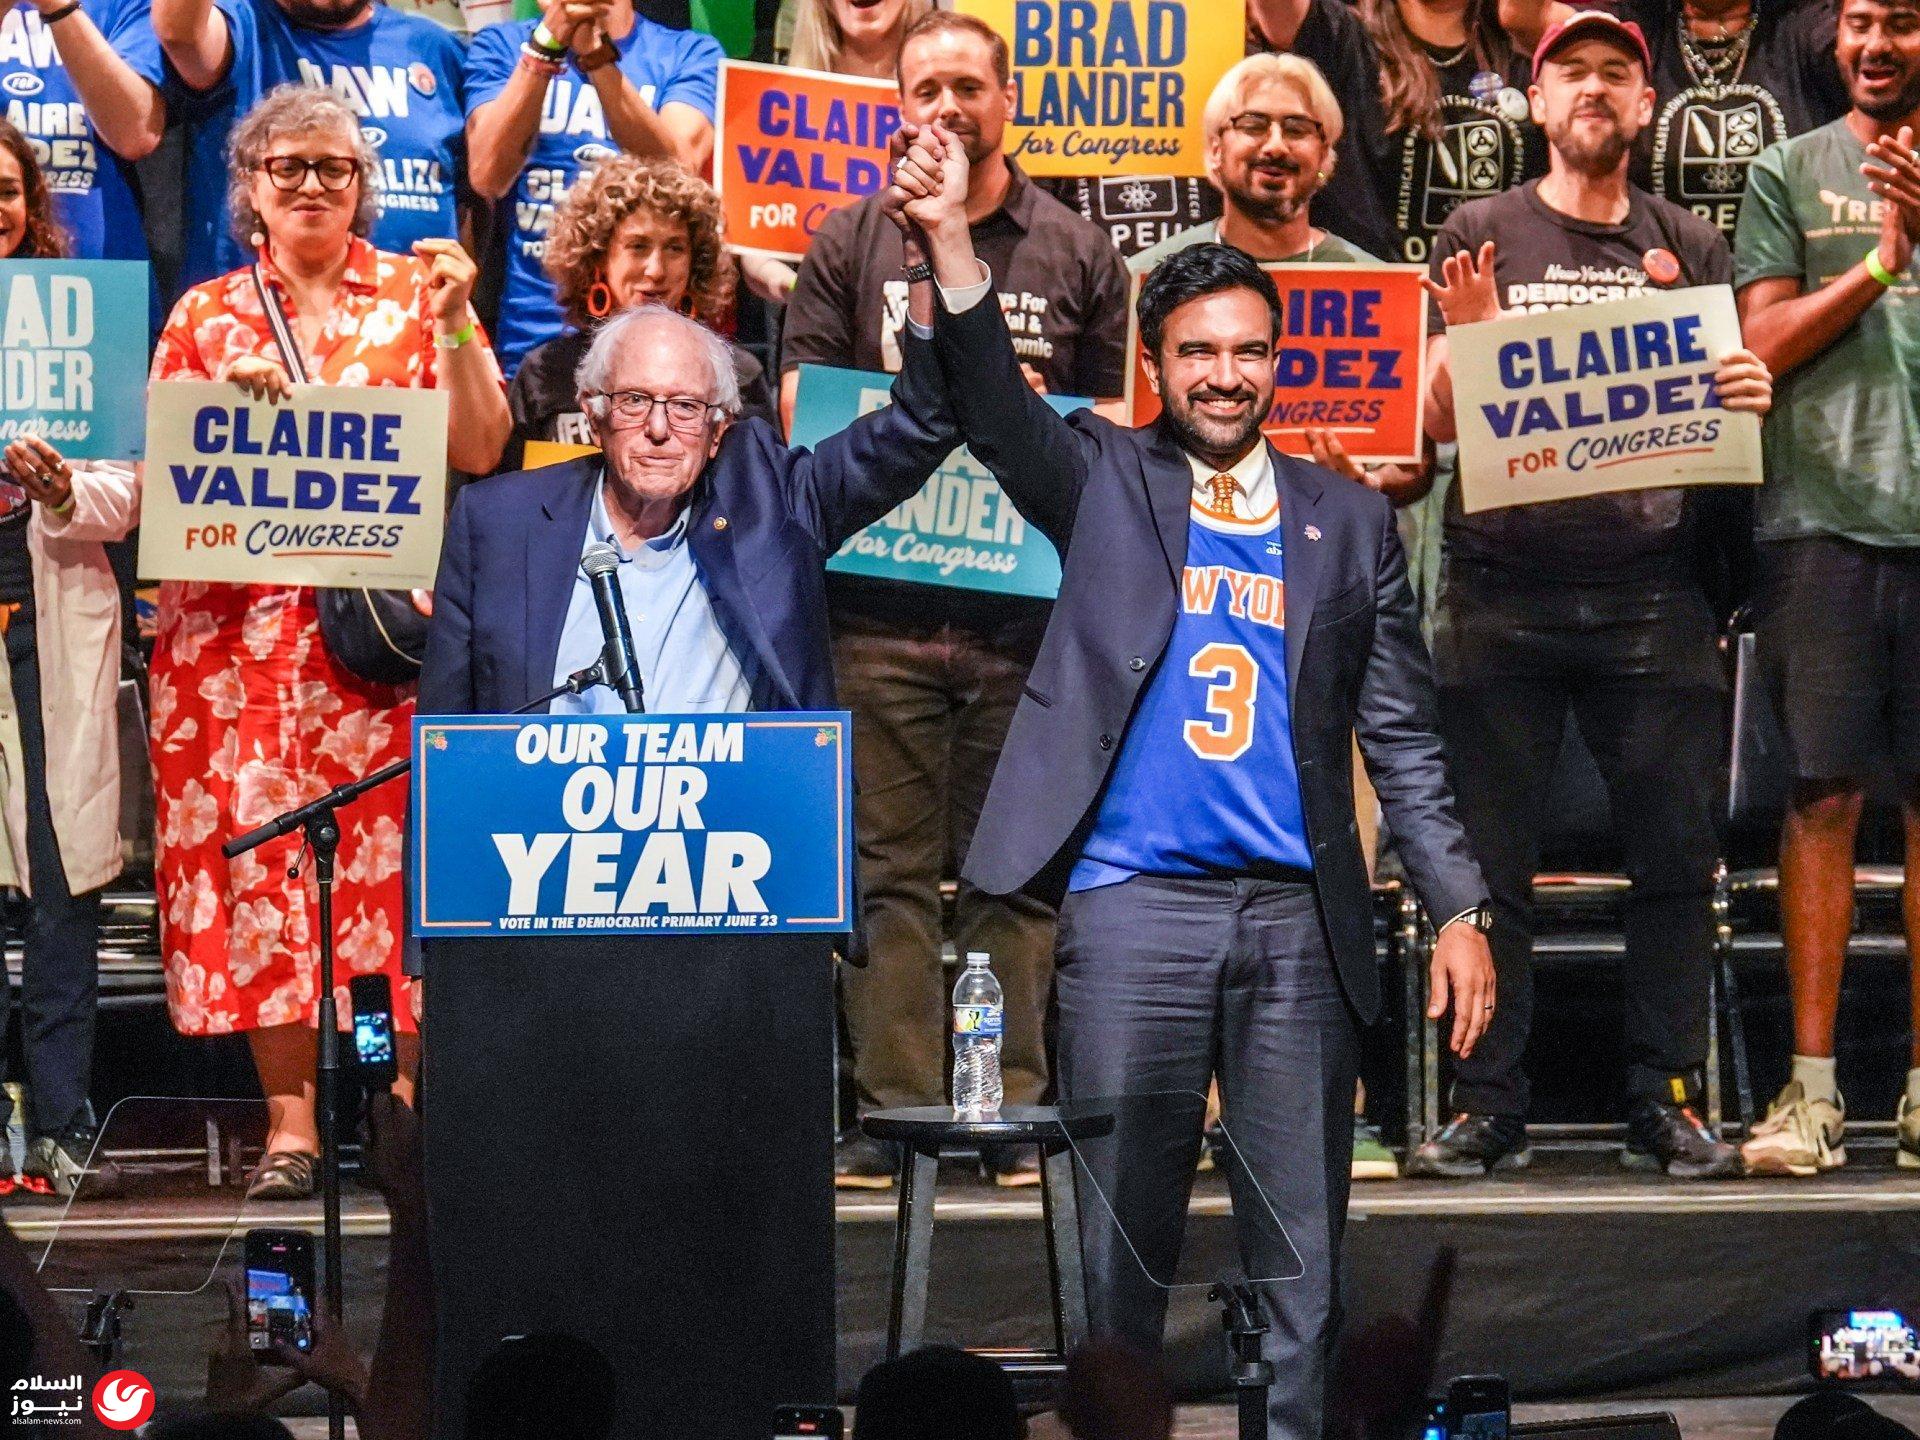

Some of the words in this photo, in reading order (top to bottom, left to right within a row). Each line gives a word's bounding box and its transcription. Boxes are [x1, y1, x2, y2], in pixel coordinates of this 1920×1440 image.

[1014, 1, 1187, 67] BRAD
[540, 79, 656, 139] UA
[1013, 71, 1185, 127] LANDER
[737, 144, 891, 197] VALD
[1013, 131, 1055, 157] for
[1063, 130, 1182, 164] Congress
[751, 202, 797, 228] FOR
[1544, 264, 1581, 281] New
[3, 274, 94, 348] AD
[1021, 292, 1048, 313] For
[1287, 289, 1381, 337] IRE
[1276, 348, 1402, 389] DEZ
[1498, 315, 1708, 390] CLAIRE
[0, 350, 94, 411] DER
[193, 405, 402, 462] CLAIRE
[1508, 447, 1558, 478] FOR
[169, 465, 421, 515] VALDEZ
[186, 524, 237, 550] FOR
[892, 532, 1018, 577] Congress
[1183, 642, 1259, 761] 3
[515, 724, 608, 764] OUR
[622, 722, 744, 763] TEAM
[562, 766, 708, 832] OUR
[491, 832, 772, 915] YEAR
[499, 917, 531, 930] VOTE
[534, 917, 549, 929] IN
[551, 917, 574, 929] THE
[577, 916, 659, 929] DEMOCRATIC
[661, 915, 723, 928] PRIMARY
[724, 915, 758, 927] JUNE
[760, 915, 778, 927] 23
